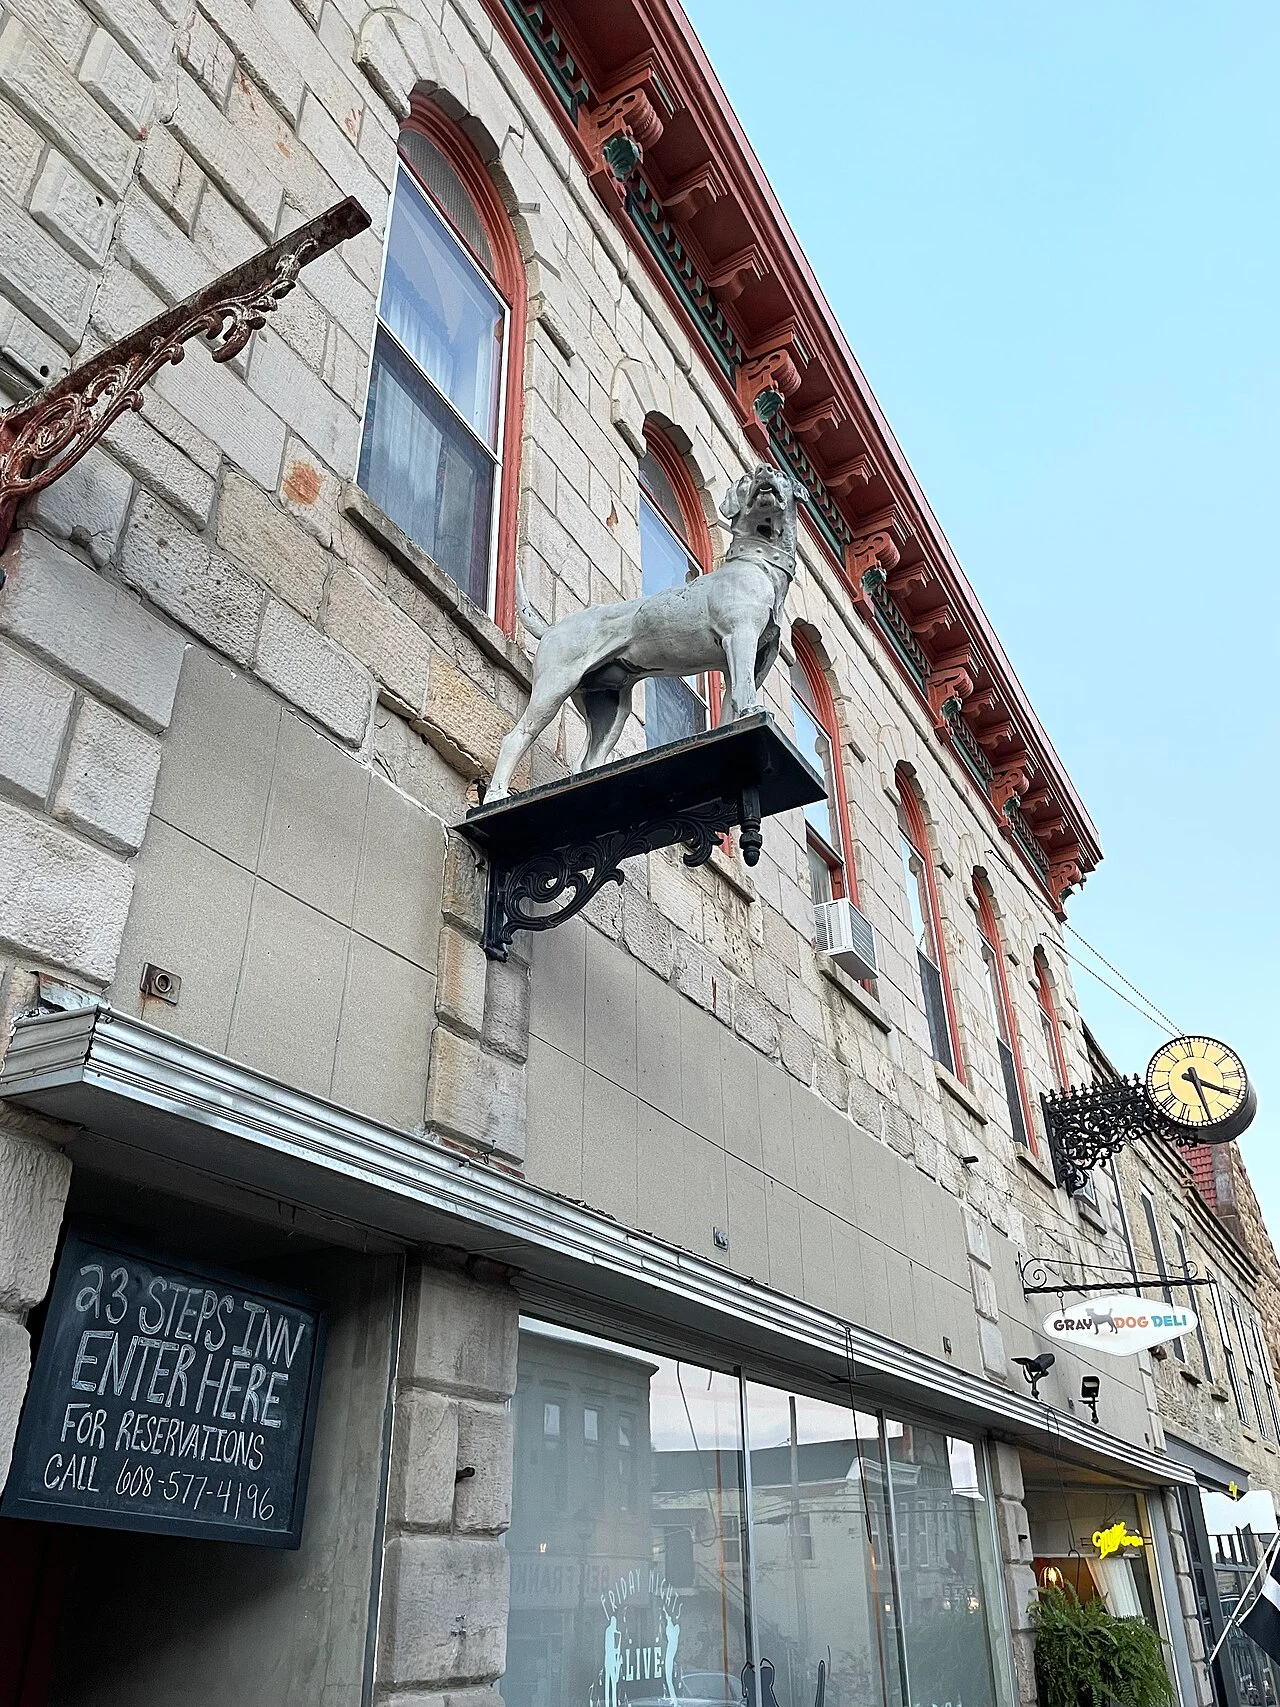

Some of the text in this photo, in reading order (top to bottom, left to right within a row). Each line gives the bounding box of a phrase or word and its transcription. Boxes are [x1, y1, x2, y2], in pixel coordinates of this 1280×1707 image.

[75, 1264, 306, 1368] 23 STEPS INN
[1053, 1314, 1188, 1331] GRAY DOG DELI
[71, 1330, 289, 1428] ENTER HERE
[60, 1403, 266, 1471] FOR RESERVATIONS
[44, 1453, 275, 1521] CALL 608-577-4196
[600, 1568, 683, 1621] FRIDAY NIGHTS
[625, 1646, 662, 1681] LIVE
